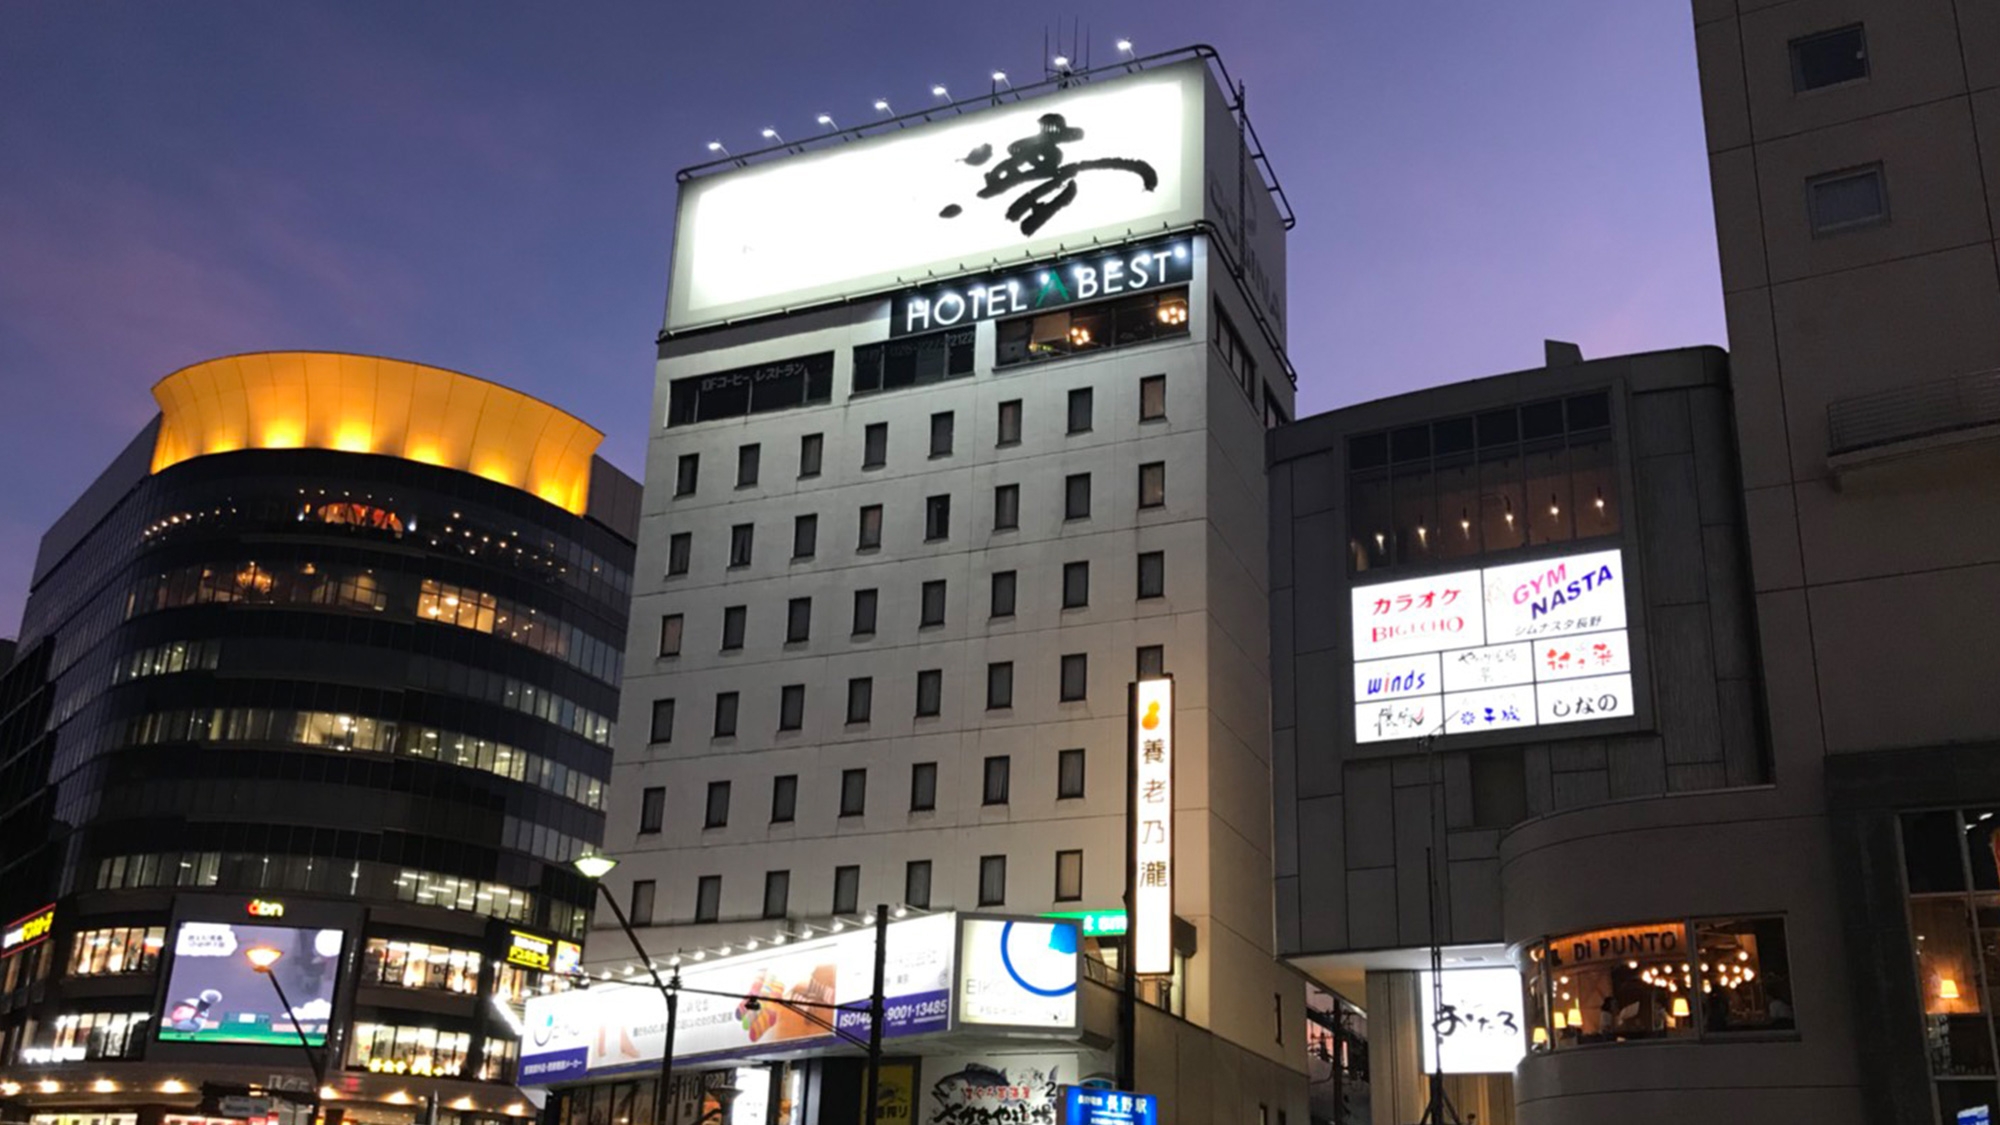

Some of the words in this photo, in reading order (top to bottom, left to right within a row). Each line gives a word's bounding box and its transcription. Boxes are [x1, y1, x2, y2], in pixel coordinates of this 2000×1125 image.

[907, 284, 1027, 332] HOTEL
[1372, 587, 1461, 616] カラオケ
[1512, 563, 1567, 606] GYM
[1531, 564, 1613, 620] NASTA
[1367, 670, 1426, 695] winds
[1139, 739, 1168, 888] 養老乃瀧
[1600, 931, 1676, 956] PUNTO
